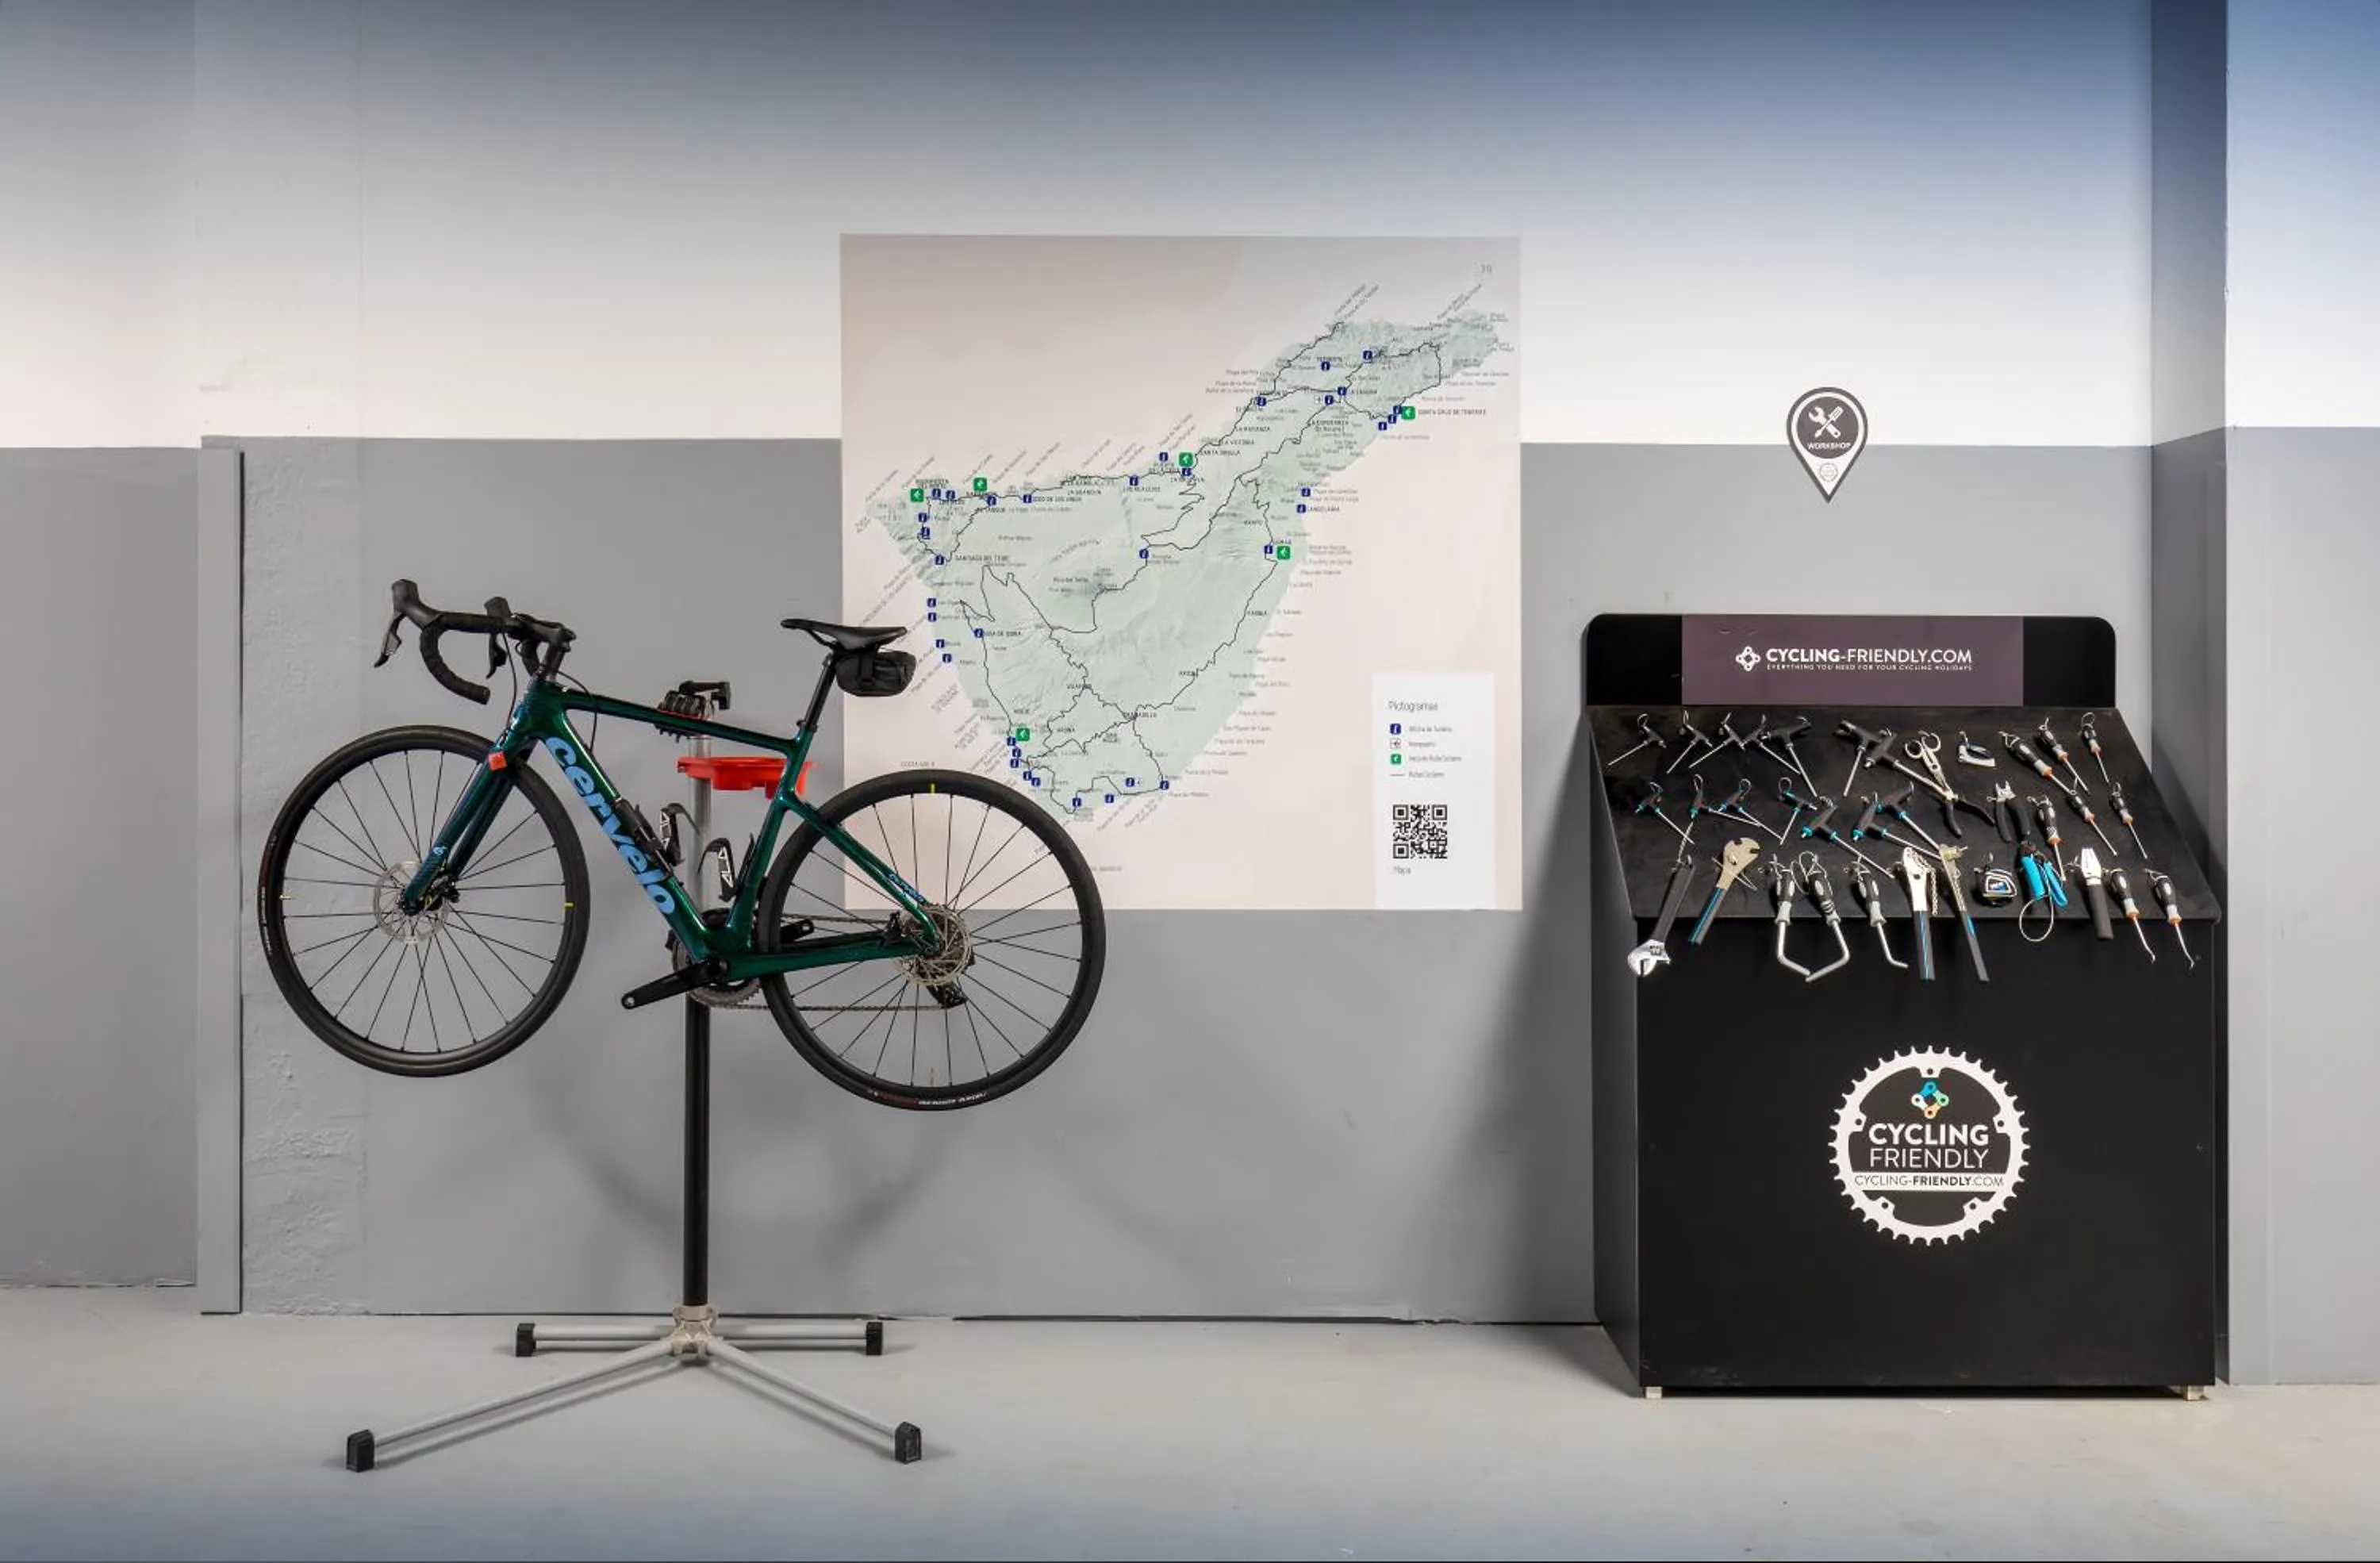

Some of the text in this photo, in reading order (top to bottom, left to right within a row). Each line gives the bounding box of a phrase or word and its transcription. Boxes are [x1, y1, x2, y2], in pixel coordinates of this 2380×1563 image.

[1766, 648, 1972, 663] CYCLING-FRIENDLY.COM
[1388, 701, 1438, 713] Pictogramas
[1868, 1123, 1990, 1146] CYCLING
[1869, 1147, 1990, 1169] FRIENDLY
[1854, 1174, 2004, 1187] CYCLING-FRIENDLY.COM
